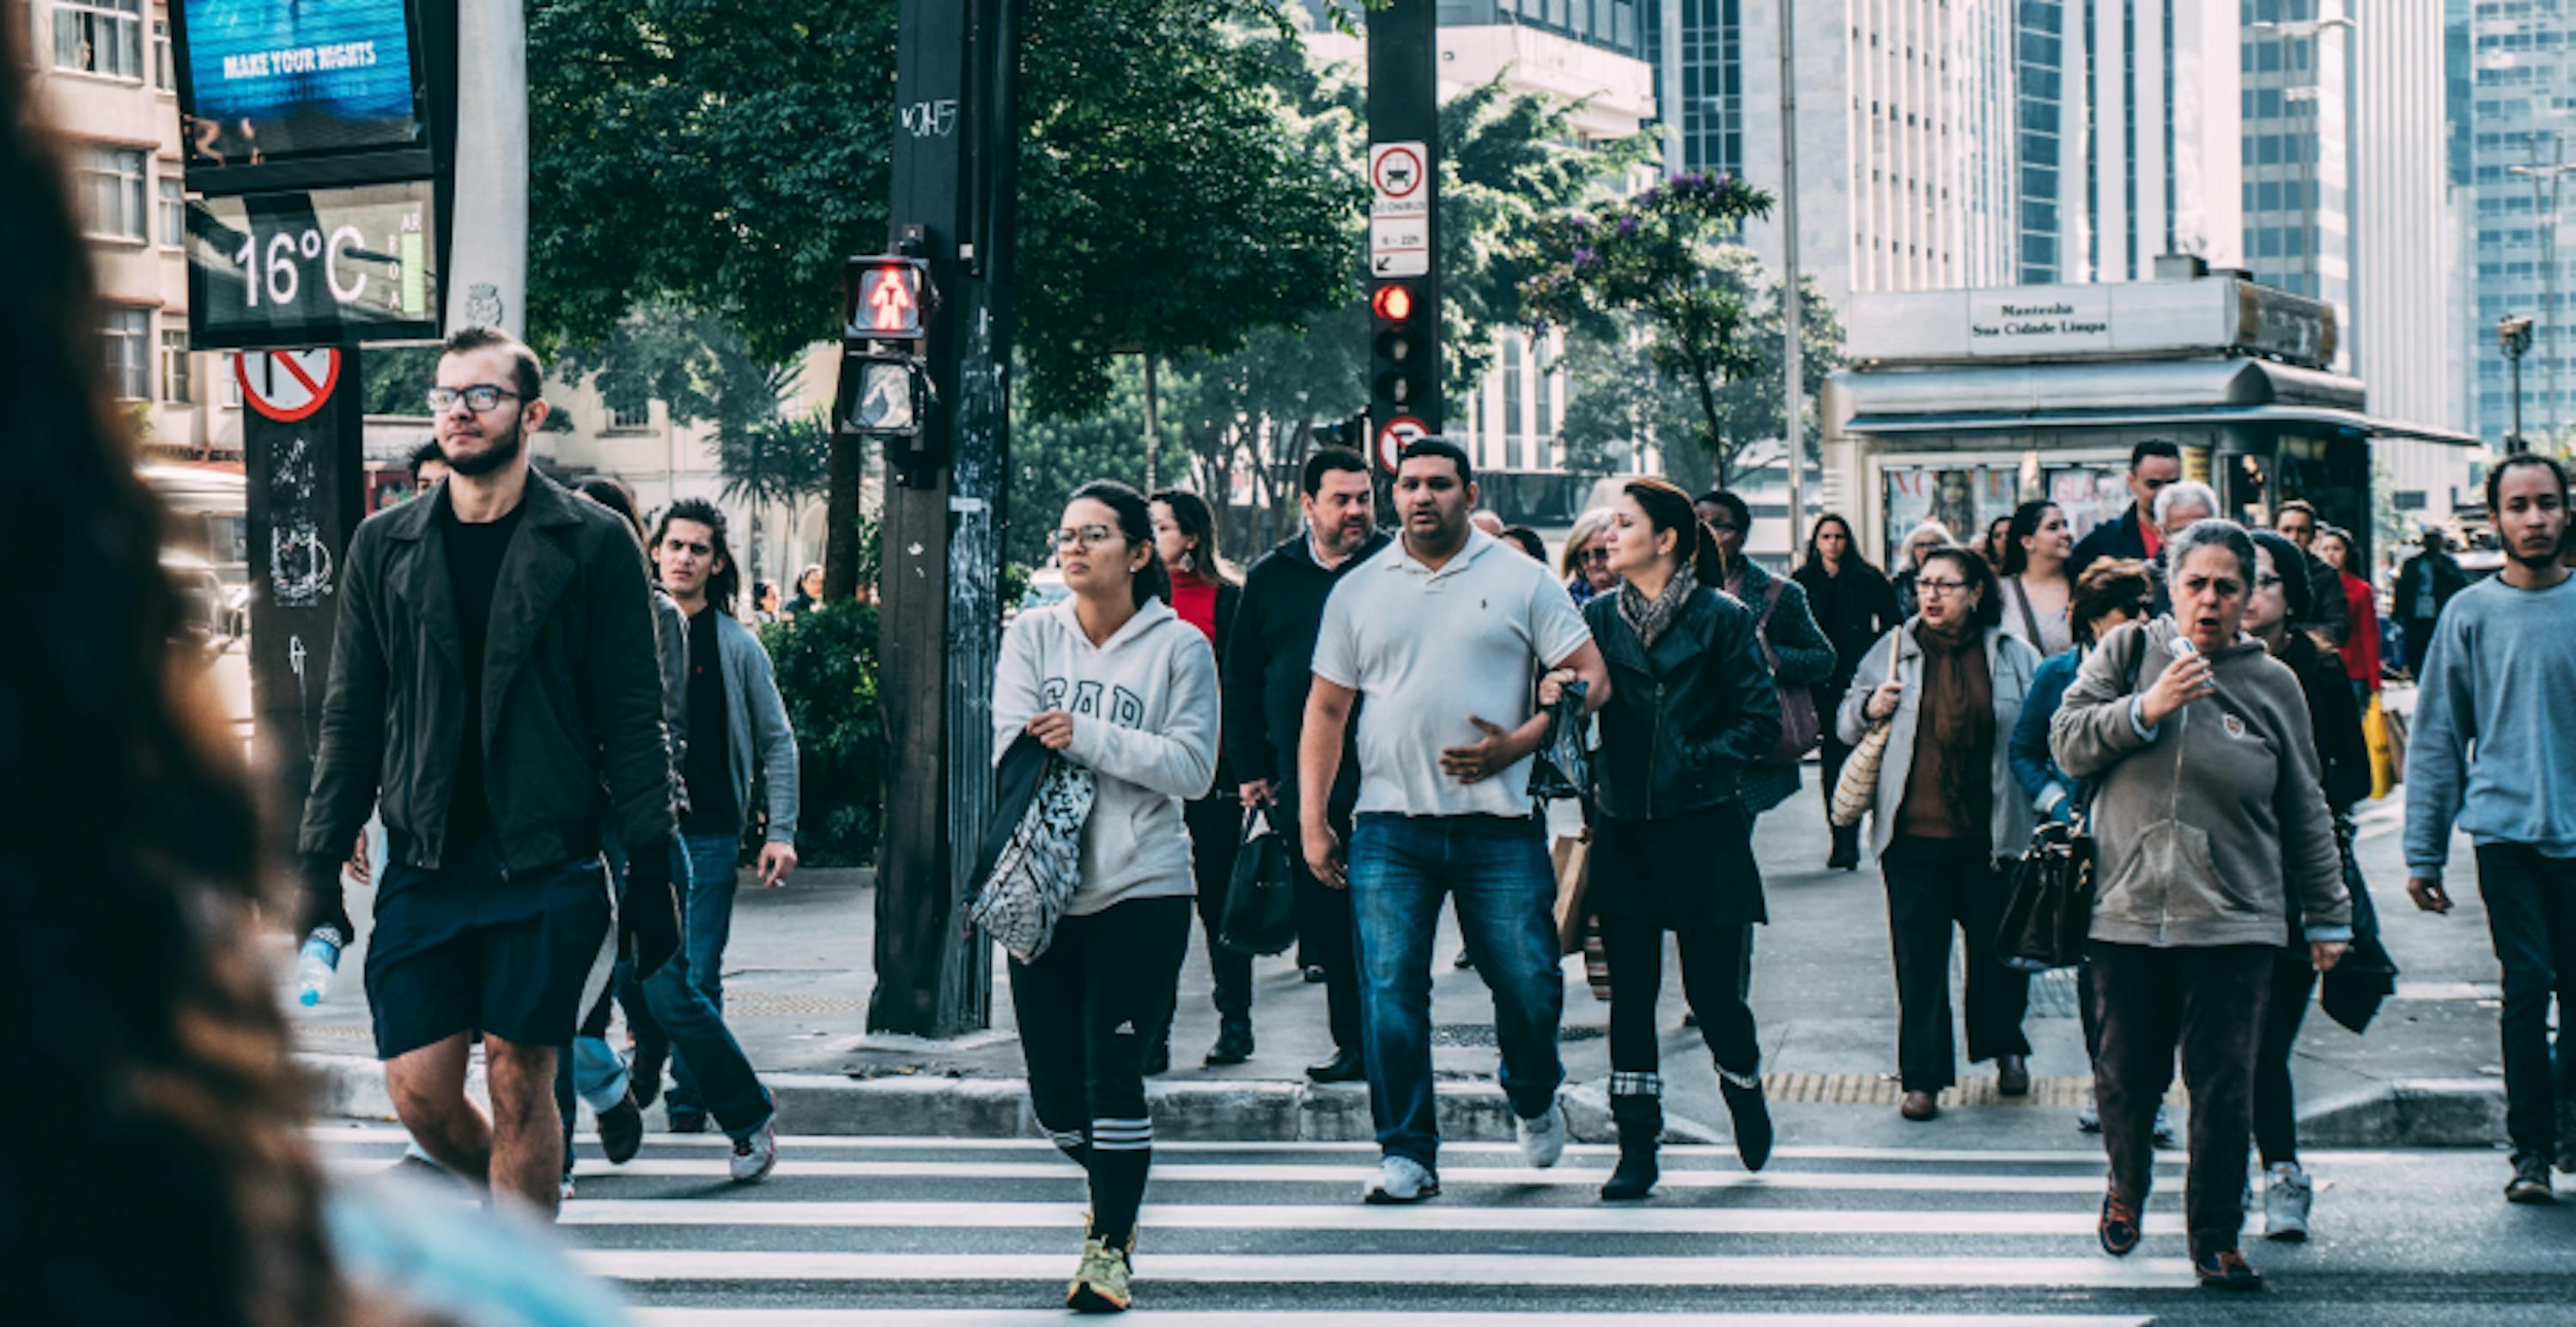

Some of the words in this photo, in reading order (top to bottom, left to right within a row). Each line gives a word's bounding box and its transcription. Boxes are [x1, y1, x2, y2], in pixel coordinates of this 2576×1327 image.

[223, 52, 270, 80] MAKE
[270, 47, 316, 75] YOUR
[317, 41, 376, 70] NIGHTS
[2001, 302, 2075, 317] Mantenha
[1971, 323, 2001, 338] Sua
[2004, 320, 2057, 336] Cidade
[2061, 319, 2107, 335] Limpa
[2052, 474, 2100, 502] GLA
